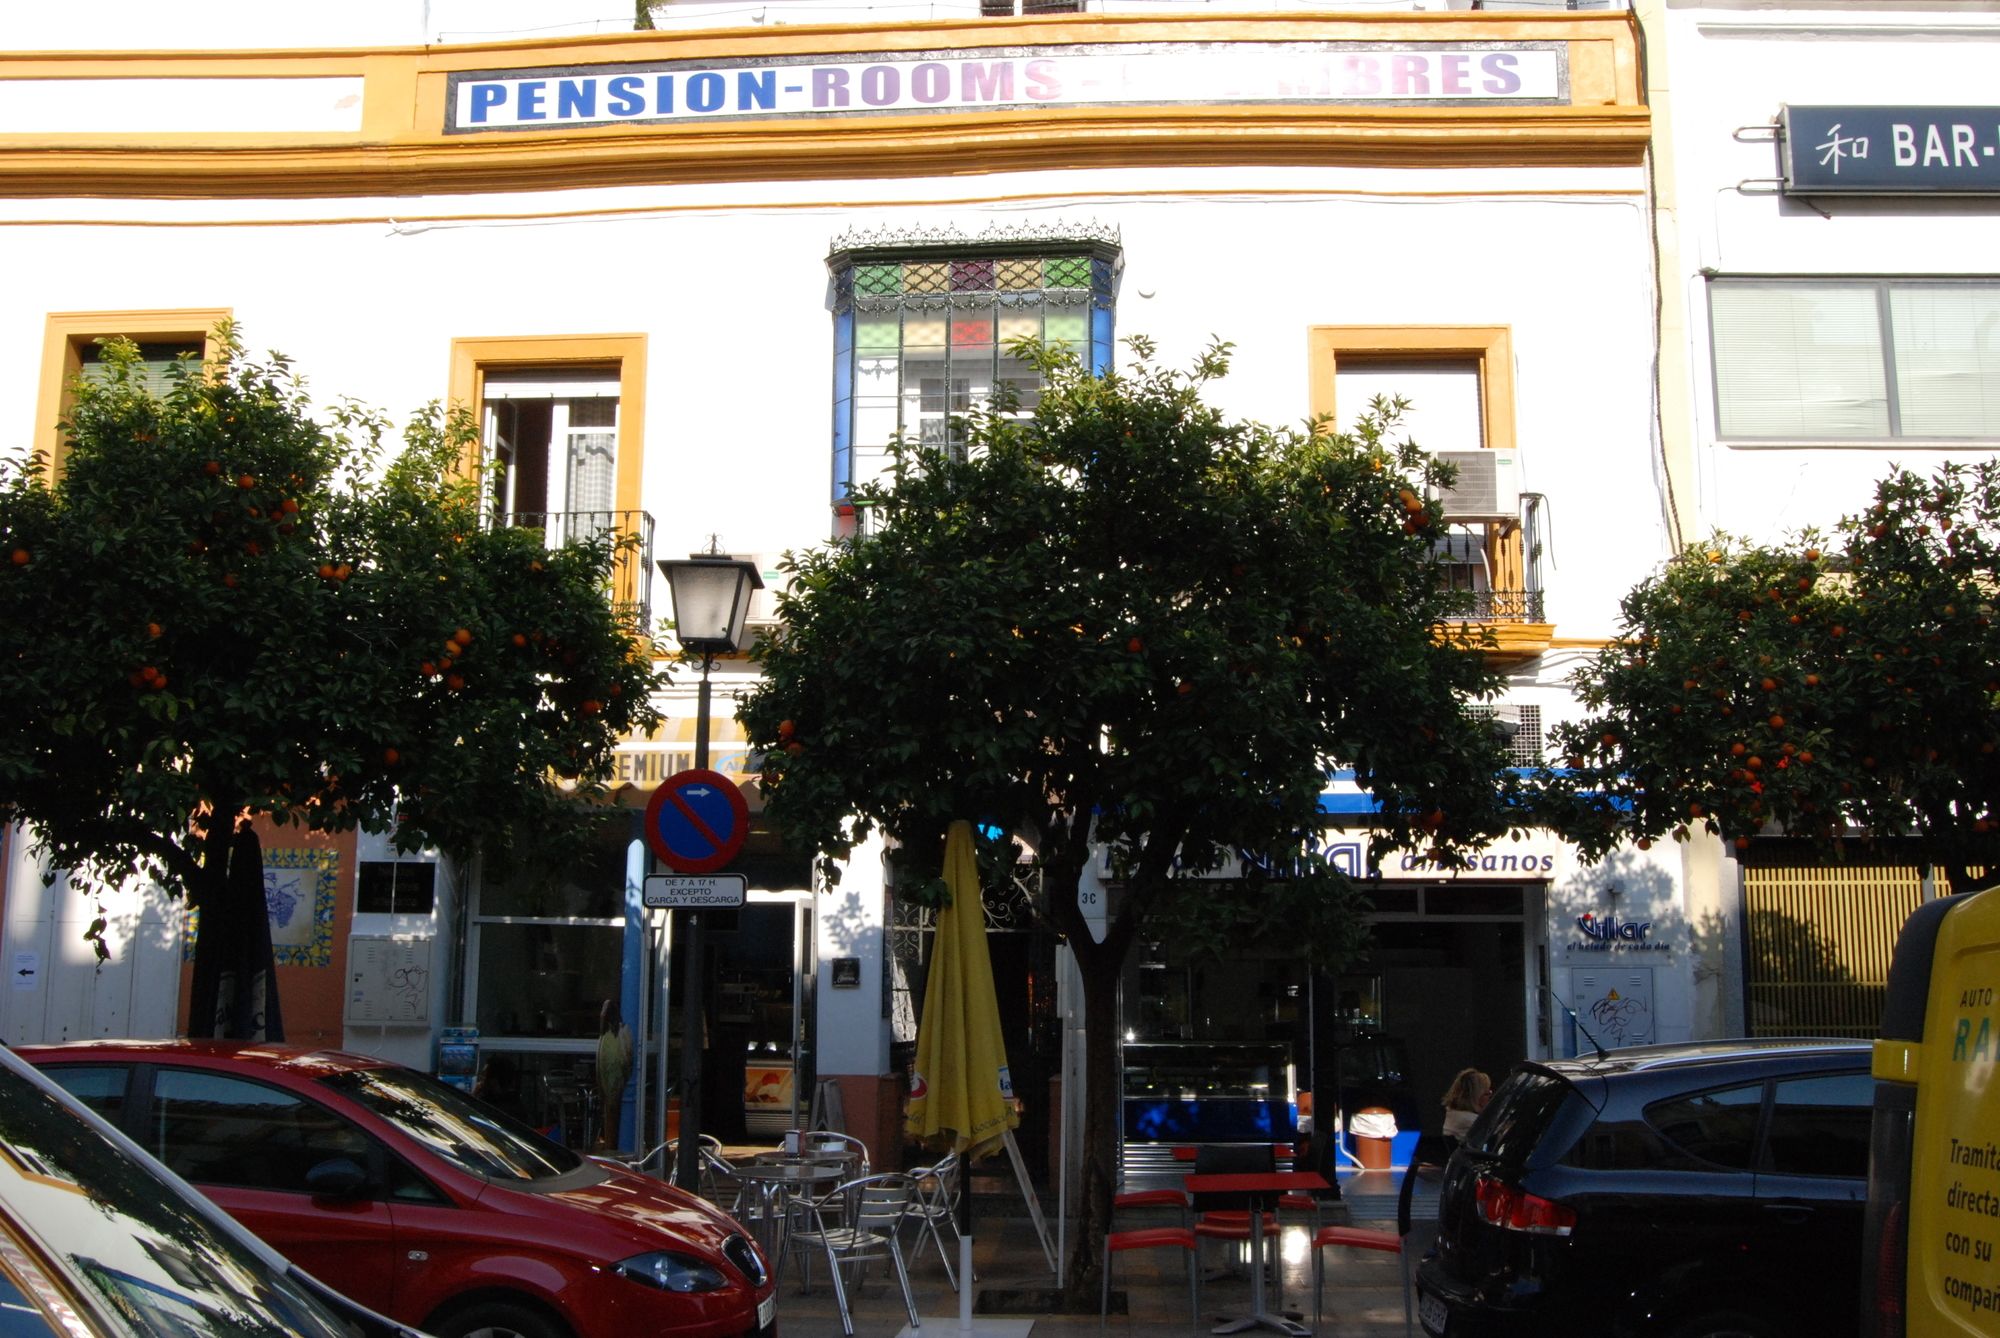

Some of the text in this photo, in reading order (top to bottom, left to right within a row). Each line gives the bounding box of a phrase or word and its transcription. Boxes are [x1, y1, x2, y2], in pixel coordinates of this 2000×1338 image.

[1814, 123, 1869, 175] 和
[1892, 123, 2000, 167] BAR-
[604, 752, 690, 782] EMIUM
[665, 878, 677, 886] DE
[680, 878, 686, 886] 7
[688, 878, 695, 886] A
[698, 878, 706, 886] 17
[670, 888, 712, 896] EXCEPTO
[647, 896, 740, 904] CARGA Y DESCARGA
[1577, 914, 1651, 940] Villar
[1578, 941, 1612, 951] helado
[1628, 942, 1651, 951] cada
[1960, 988, 1992, 1008] AUTO
[1952, 1016, 2000, 1062] RA
[1947, 1180, 2000, 1217] directa
[1944, 1231, 1993, 1263] con su
